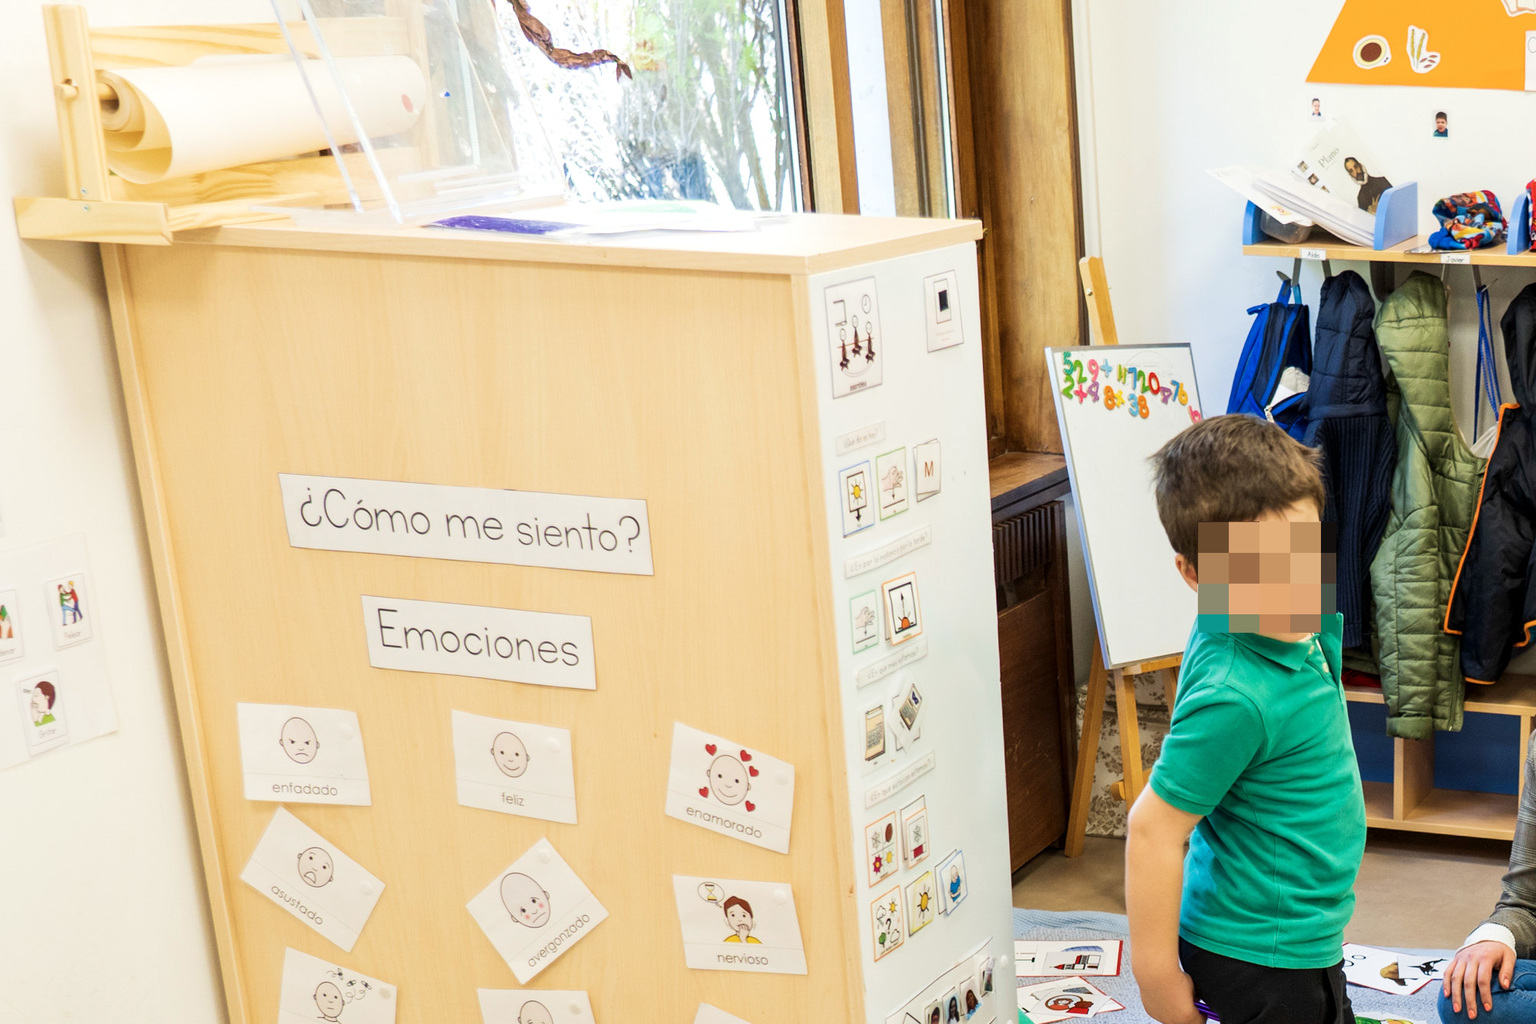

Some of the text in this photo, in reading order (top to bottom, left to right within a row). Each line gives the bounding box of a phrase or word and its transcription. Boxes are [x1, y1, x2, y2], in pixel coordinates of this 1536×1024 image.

[1317, 147, 1340, 168] Plano
[924, 460, 934, 478] M
[299, 486, 642, 554] ¿Cómo me siento?
[376, 607, 581, 667] Emociones
[271, 781, 338, 797] enfadado
[500, 791, 524, 808] feliz
[686, 804, 763, 841] enamorado
[270, 883, 324, 927] asustado
[526, 911, 591, 970] avergonzado
[717, 950, 769, 966] nervioso
